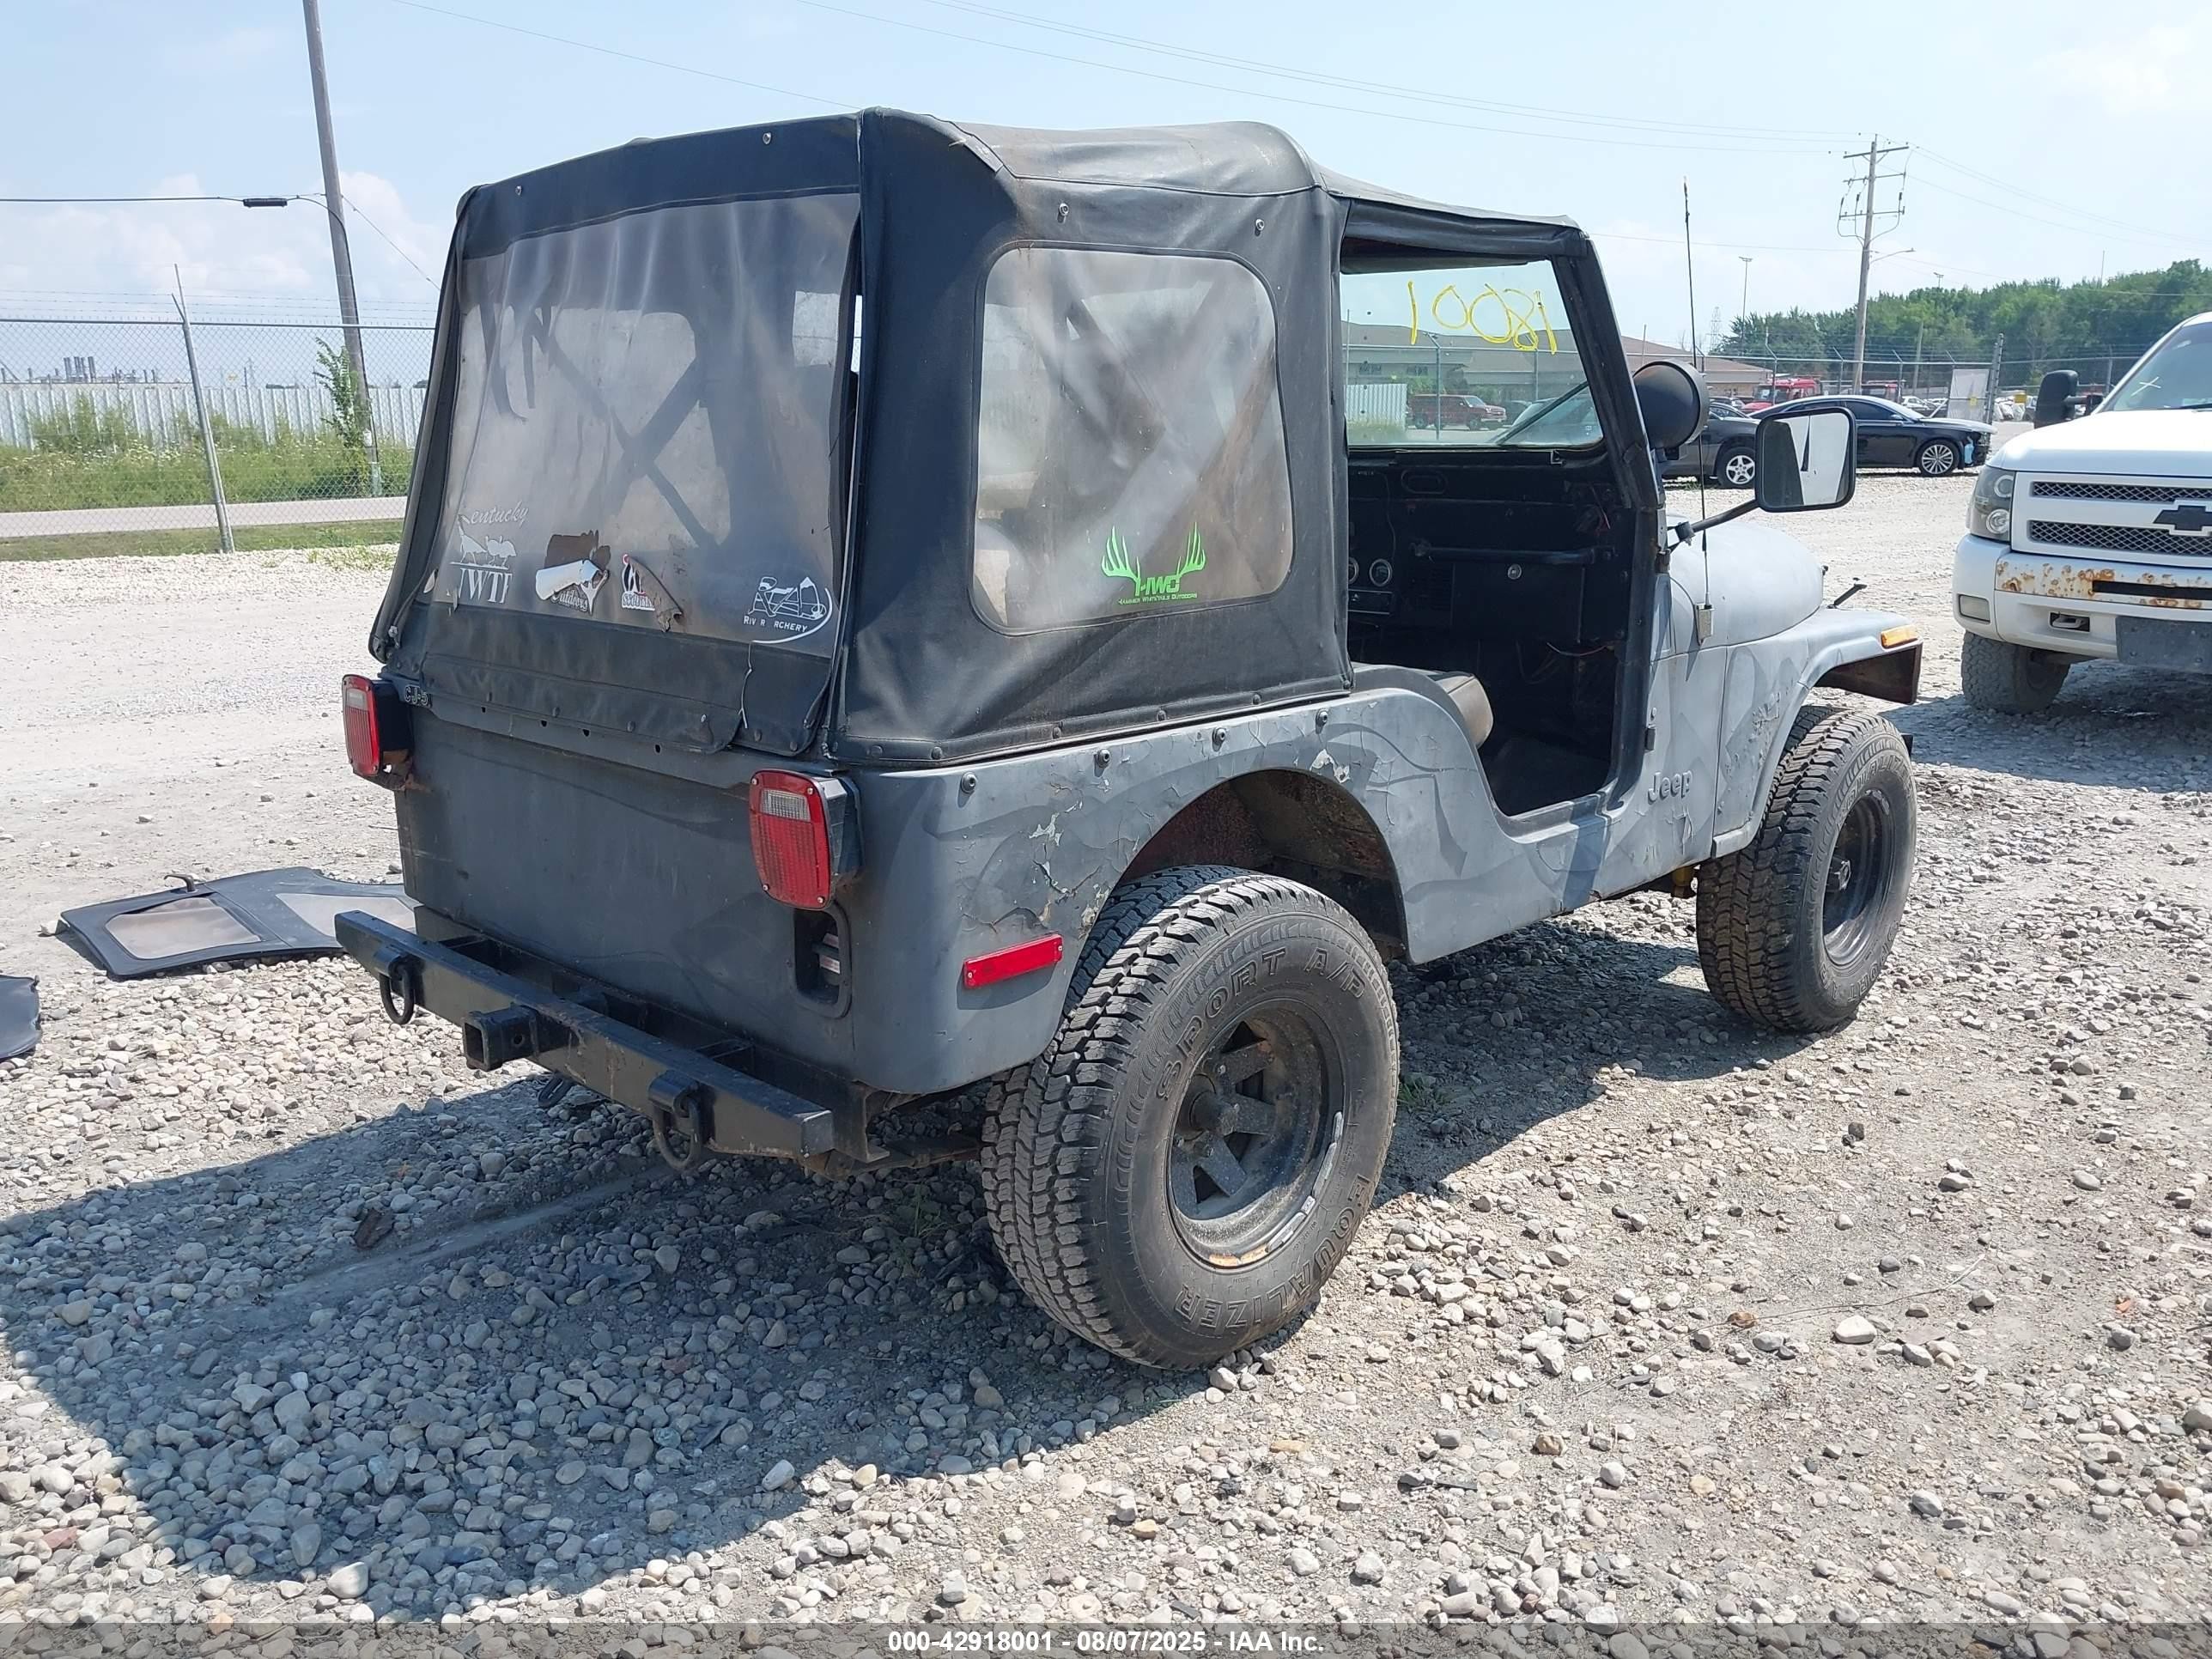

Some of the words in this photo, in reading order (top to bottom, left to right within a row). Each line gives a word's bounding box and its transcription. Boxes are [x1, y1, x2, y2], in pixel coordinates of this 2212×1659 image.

[1407, 281, 1557, 356] 10081
[1647, 769, 1692, 805] Jeep
[1156, 946, 1286, 1102] SPORT
[1173, 1173, 1373, 1329] EQUALIZER
